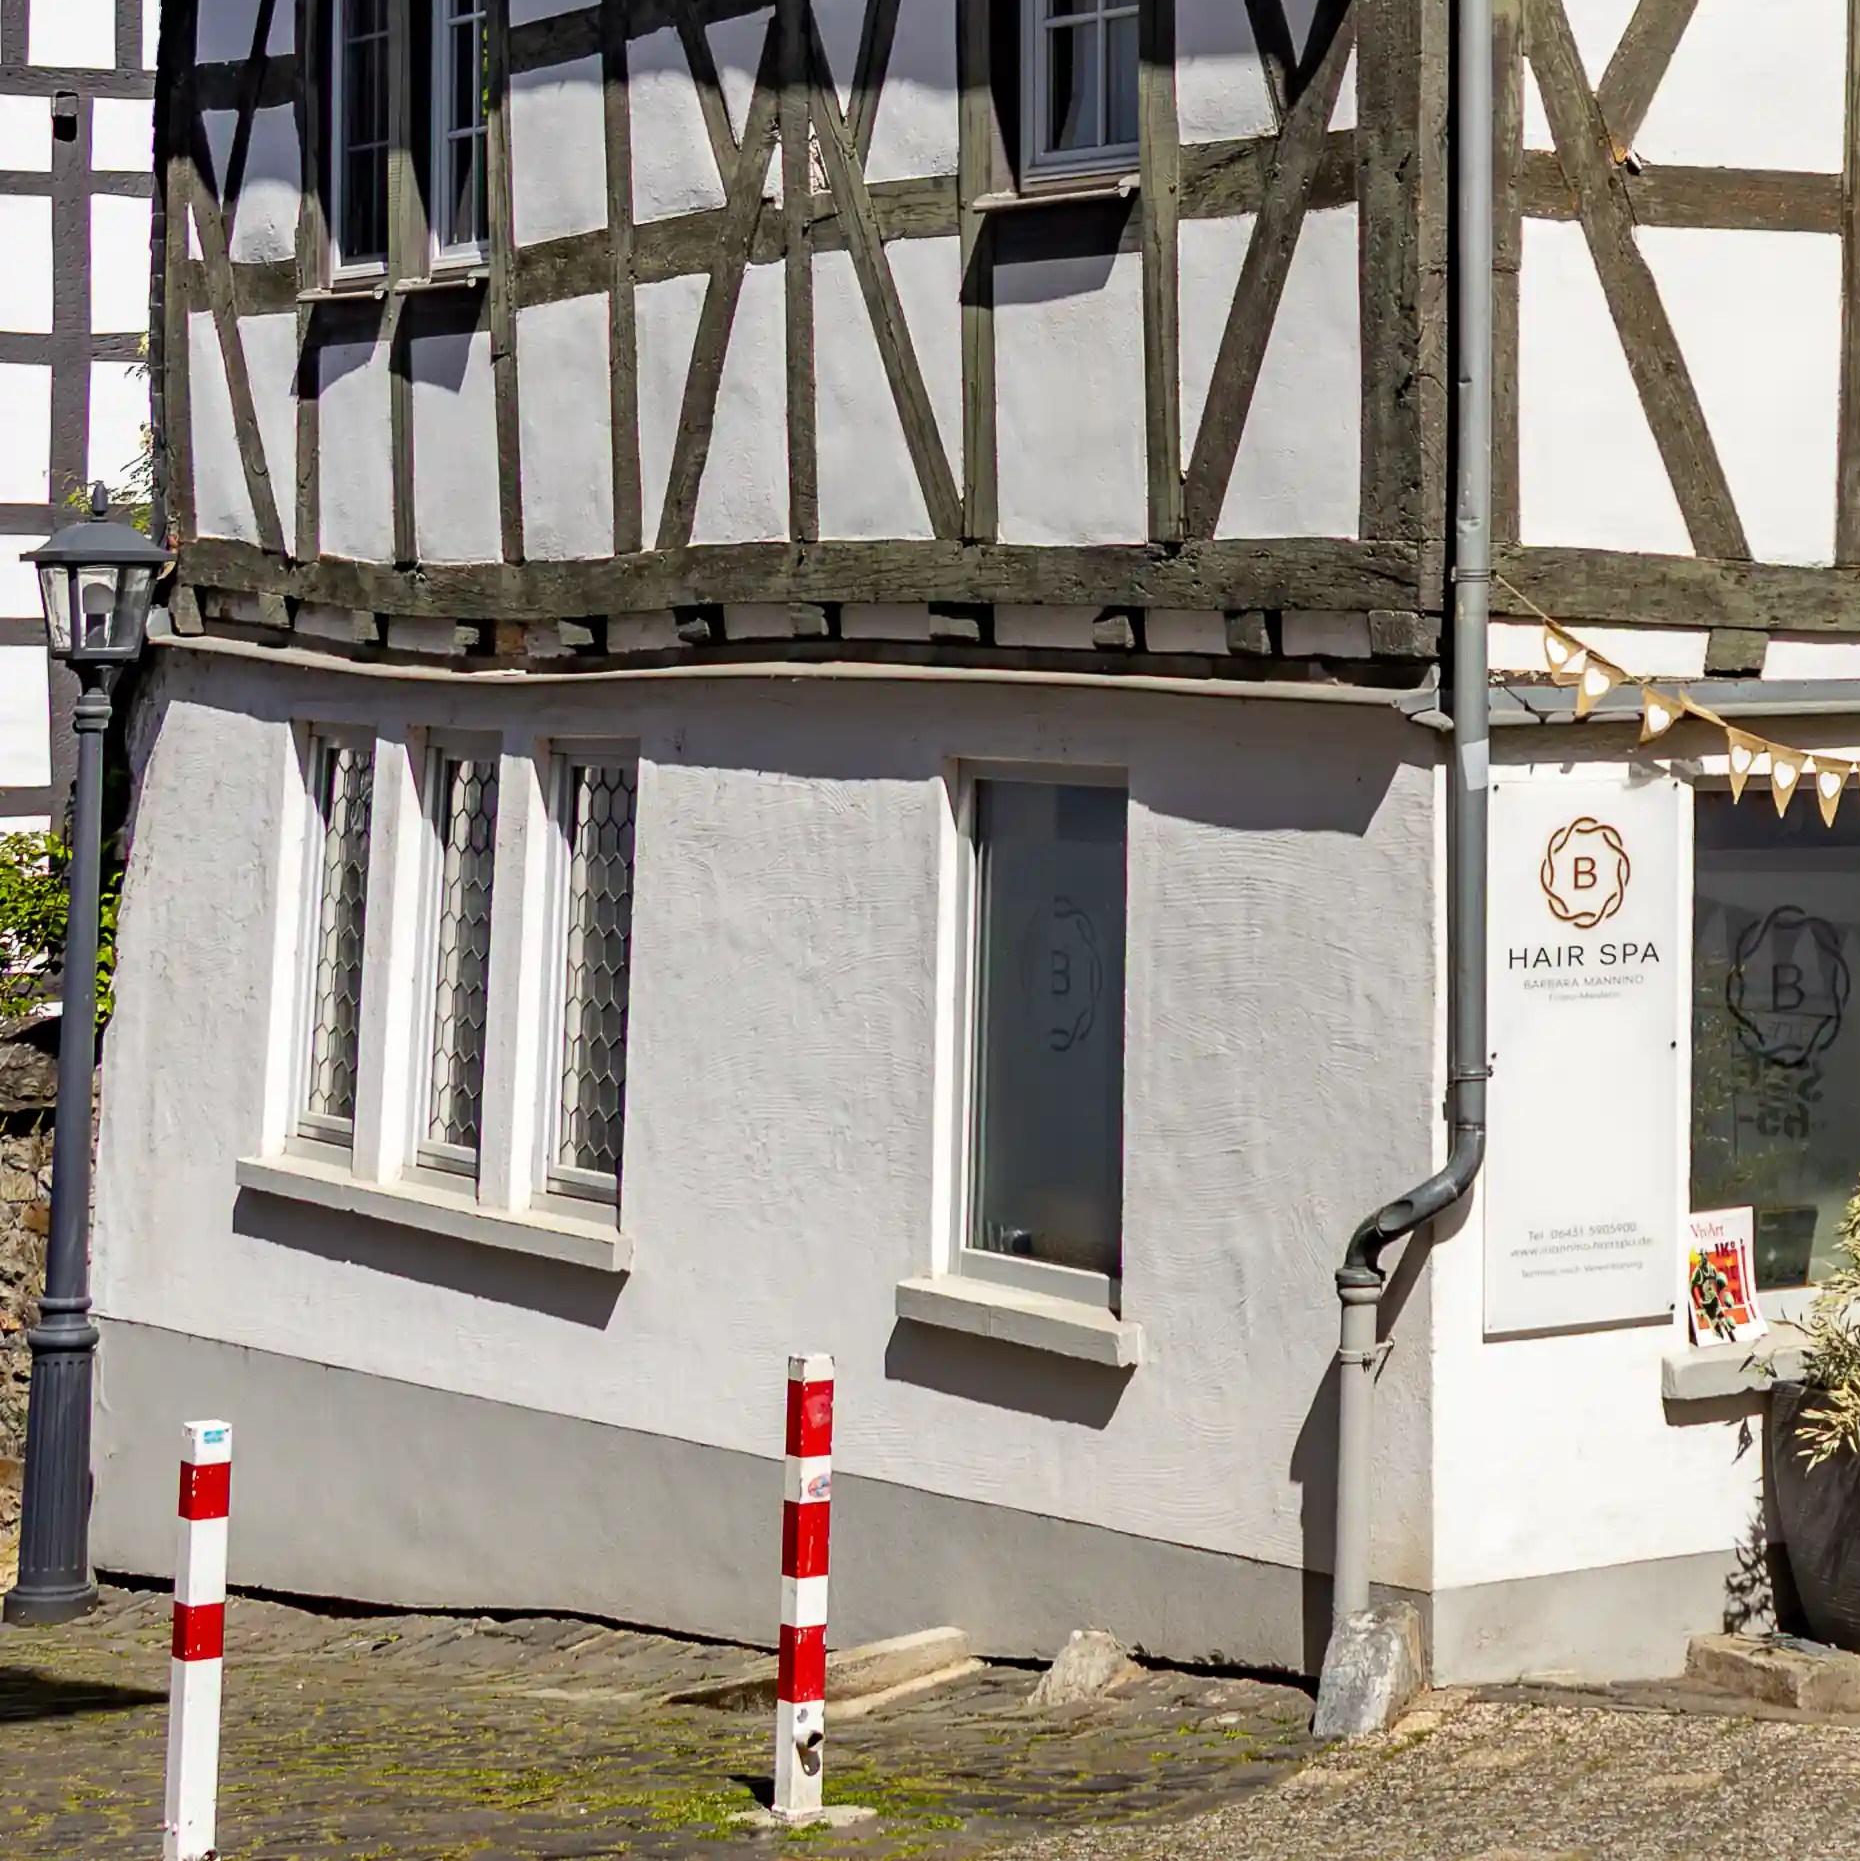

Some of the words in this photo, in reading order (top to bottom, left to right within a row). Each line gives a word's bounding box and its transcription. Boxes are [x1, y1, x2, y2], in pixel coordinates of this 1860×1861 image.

[1573, 856, 1598, 890] B
[1508, 945, 1585, 970] HAIR
[1599, 941, 1660, 966] SPA
[1523, 977, 1580, 990] BARBARA
[1584, 973, 1644, 987] MANNINO
[1772, 963, 1805, 1012] B
